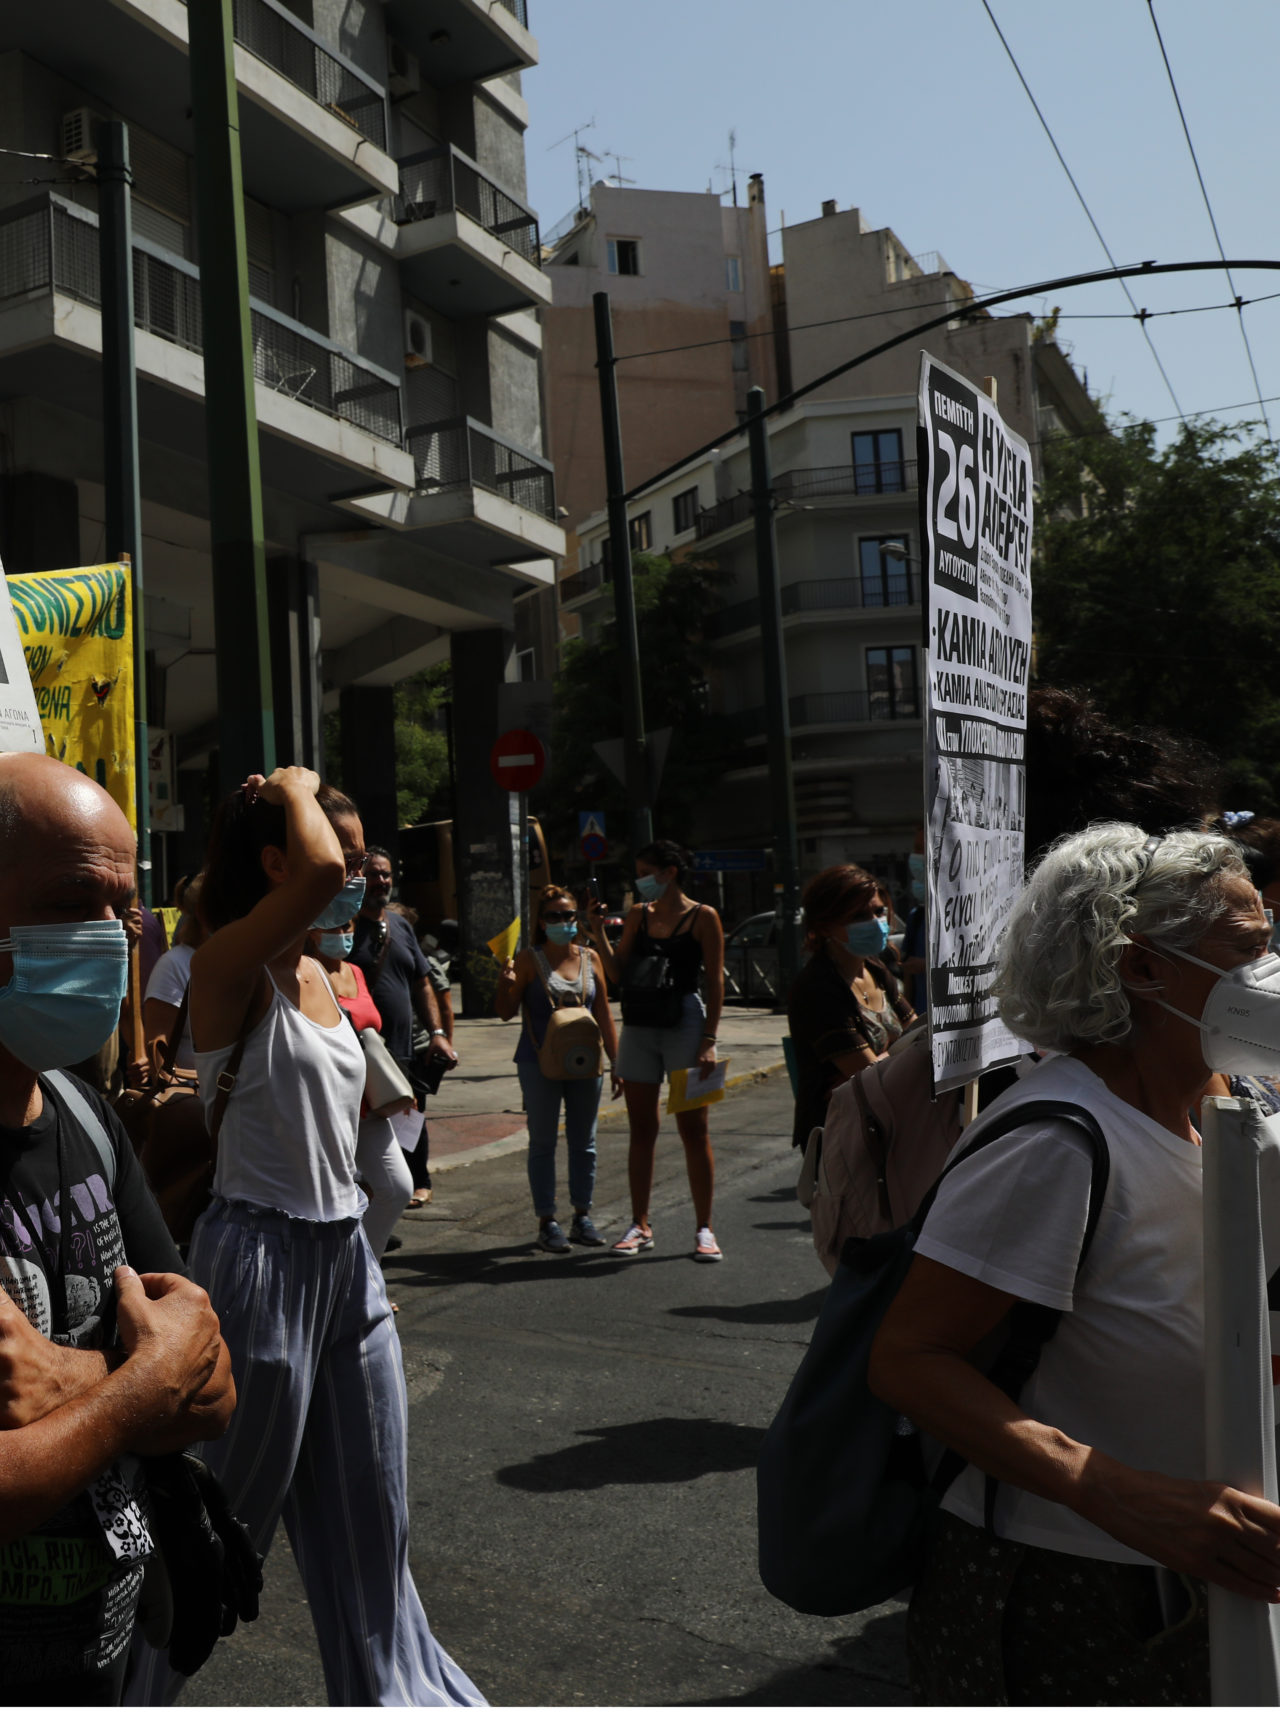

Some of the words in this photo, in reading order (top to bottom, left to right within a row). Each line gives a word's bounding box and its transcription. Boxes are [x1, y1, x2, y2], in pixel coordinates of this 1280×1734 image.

[934, 390, 974, 435] ΠΕΜΠΤΗ
[937, 429, 976, 550] 26
[938, 549, 976, 587] ΑΥΓΟΥΣΤΟΥ
[937, 608, 987, 671] ΚΑΜΙΑ
[936, 671, 972, 706] ΚΑΜΙΑ
